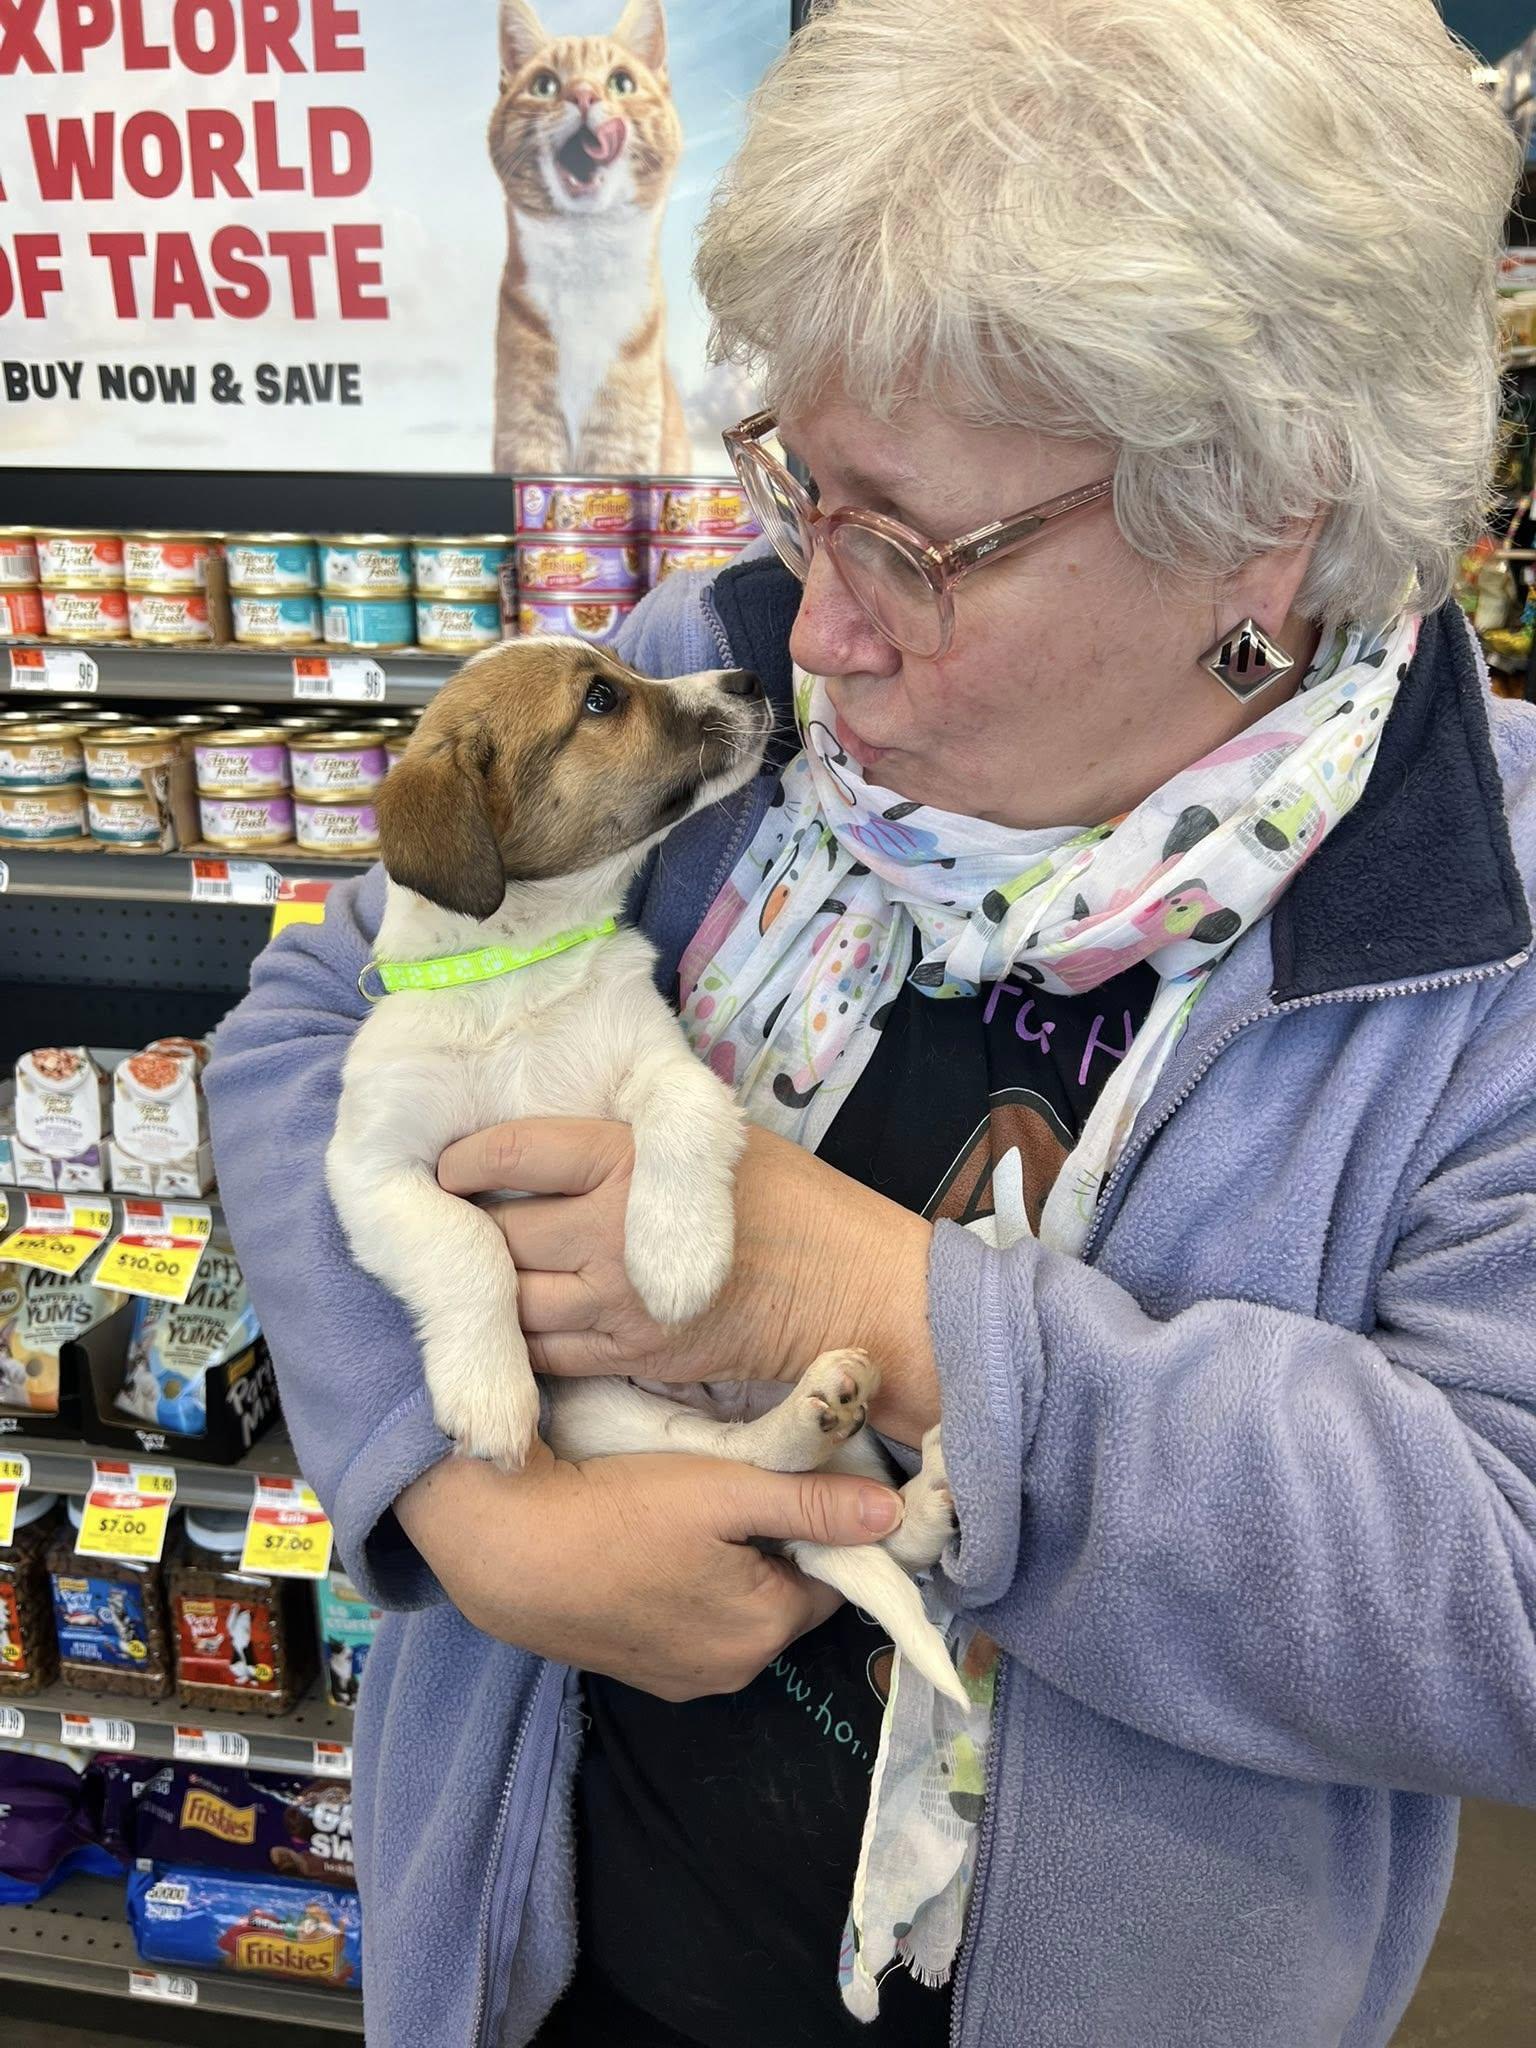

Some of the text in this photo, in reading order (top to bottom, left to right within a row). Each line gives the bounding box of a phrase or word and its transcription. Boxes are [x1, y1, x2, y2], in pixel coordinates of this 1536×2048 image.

[0, 0, 366, 75] XPLORE
[25, 101, 373, 202] WORLD
[0, 224, 390, 320] F TASTE
[5, 361, 363, 405] BUY NOW & SAVE
[208, 753, 249, 768] Fancy
[319, 757, 360, 771] Fancy
[215, 766, 249, 778] Feast
[326, 769, 361, 782] Feast
[228, 806, 269, 820] Fancy
[319, 813, 360, 827] Fancy
[233, 817, 268, 832] Feast
[326, 824, 360, 838] Feast
[26, 1302, 93, 1327] YUMS
[167, 1320, 229, 1350] YUMS
[100, 1519, 146, 1535] $7.00
[265, 1535, 314, 1552] $7.00
[188, 1797, 250, 1839] Friskies
[246, 1941, 332, 1973] Friskies
